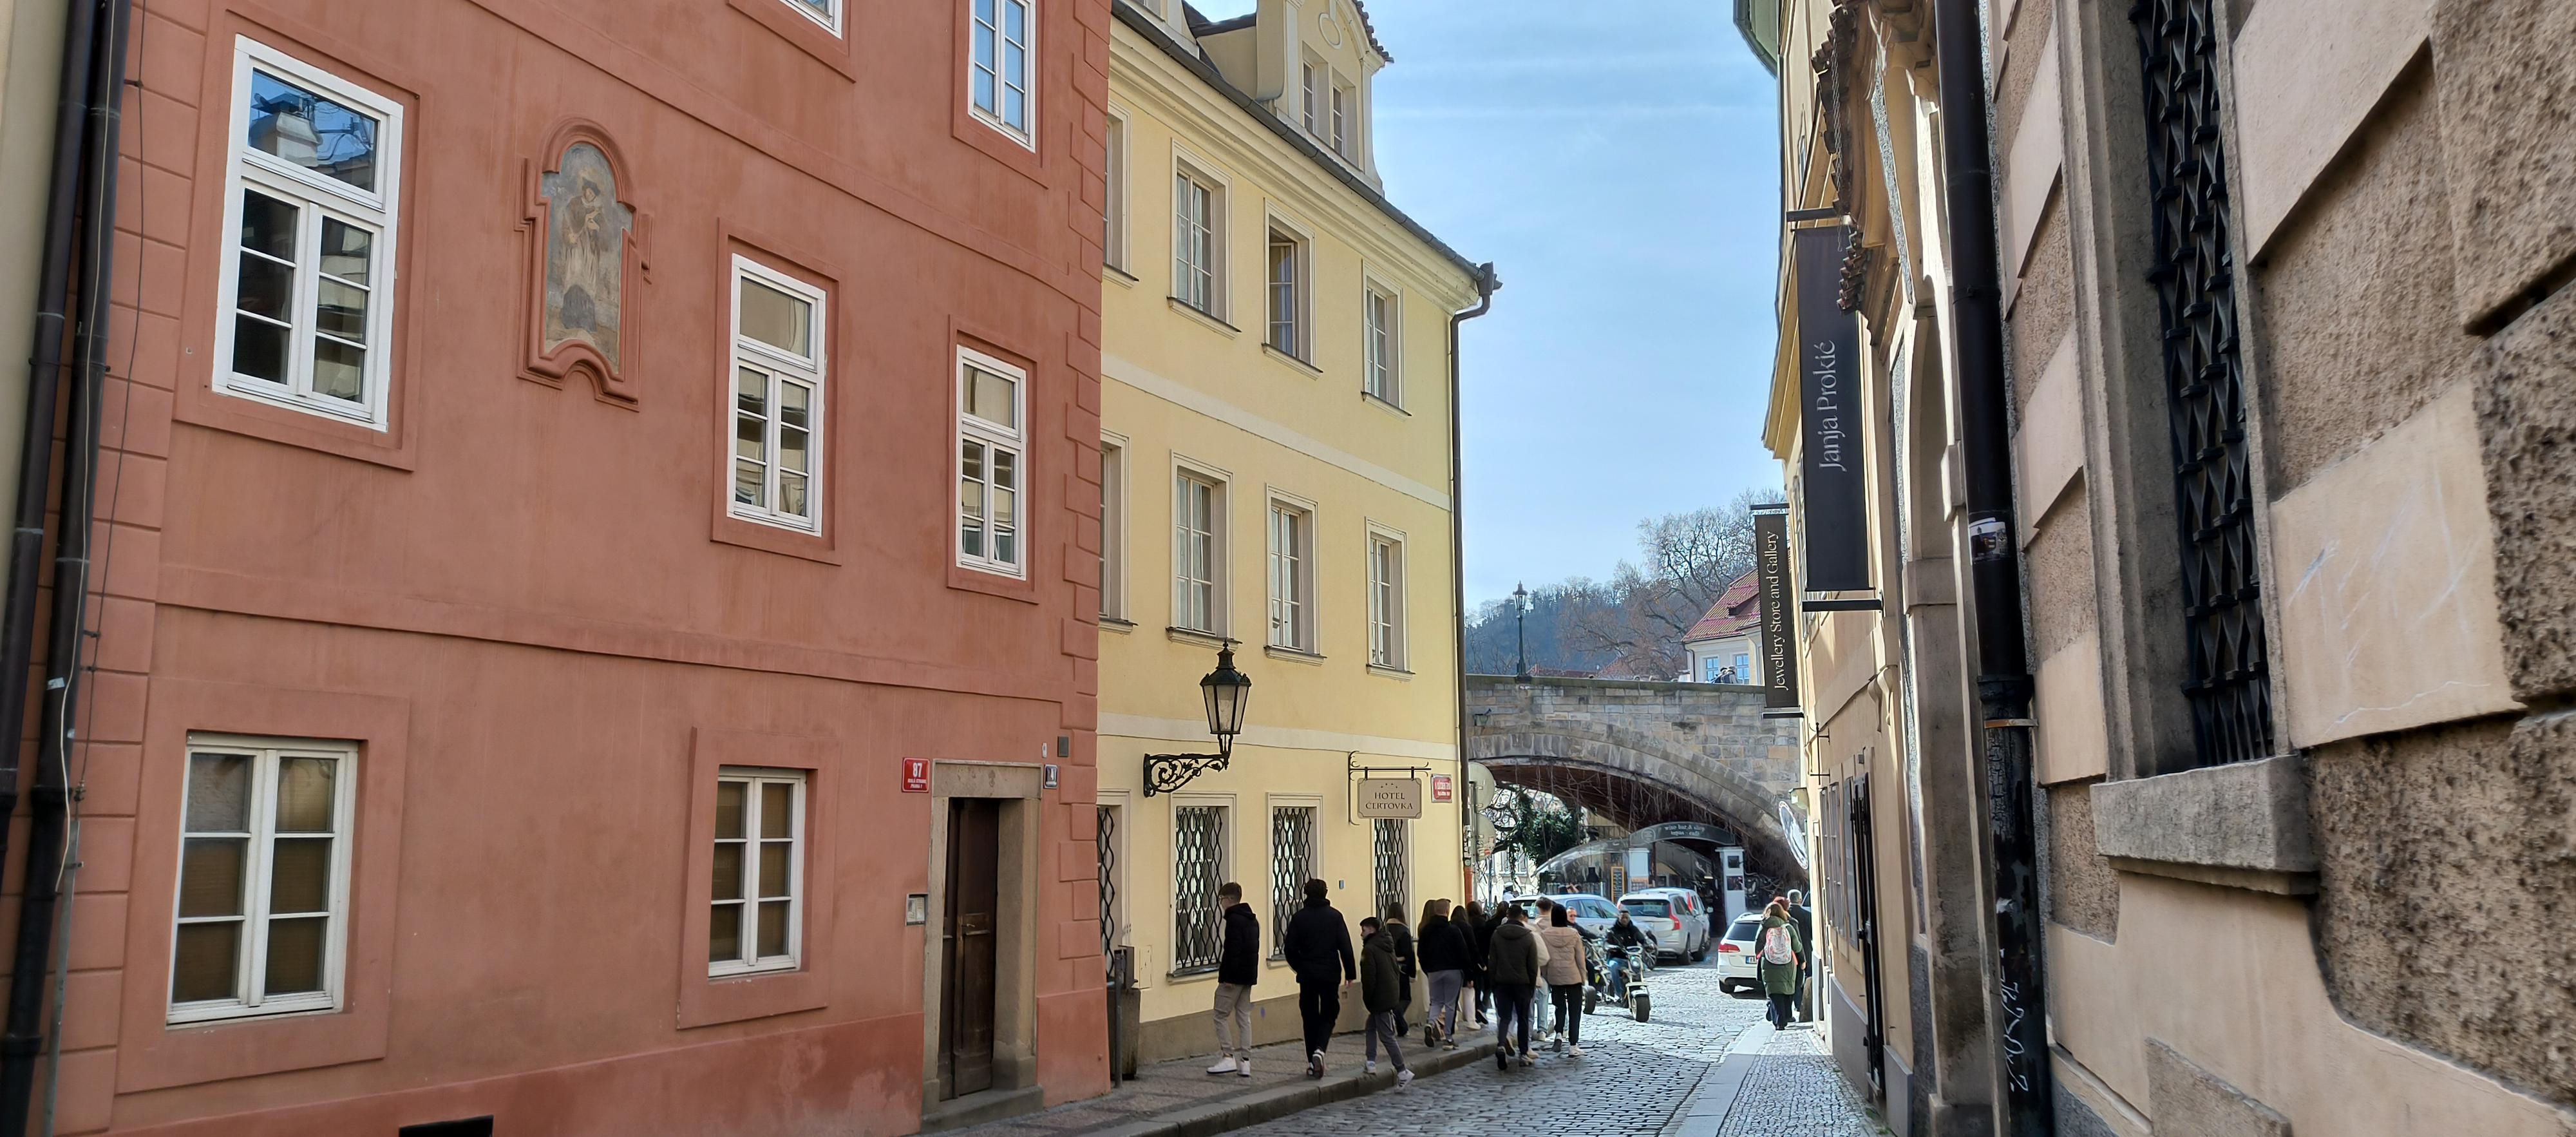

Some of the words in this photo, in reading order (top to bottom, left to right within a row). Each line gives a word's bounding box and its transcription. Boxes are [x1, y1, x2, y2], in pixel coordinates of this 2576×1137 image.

[1813, 339, 1837, 410] Prokić
[1817, 415, 1847, 472] Janja
[1764, 530, 1779, 574] Gallery
[1766, 576, 1779, 599] and
[1771, 600, 1781, 632] Store
[1771, 634, 1788, 691] Jewellery
[913, 762, 923, 778] 87
